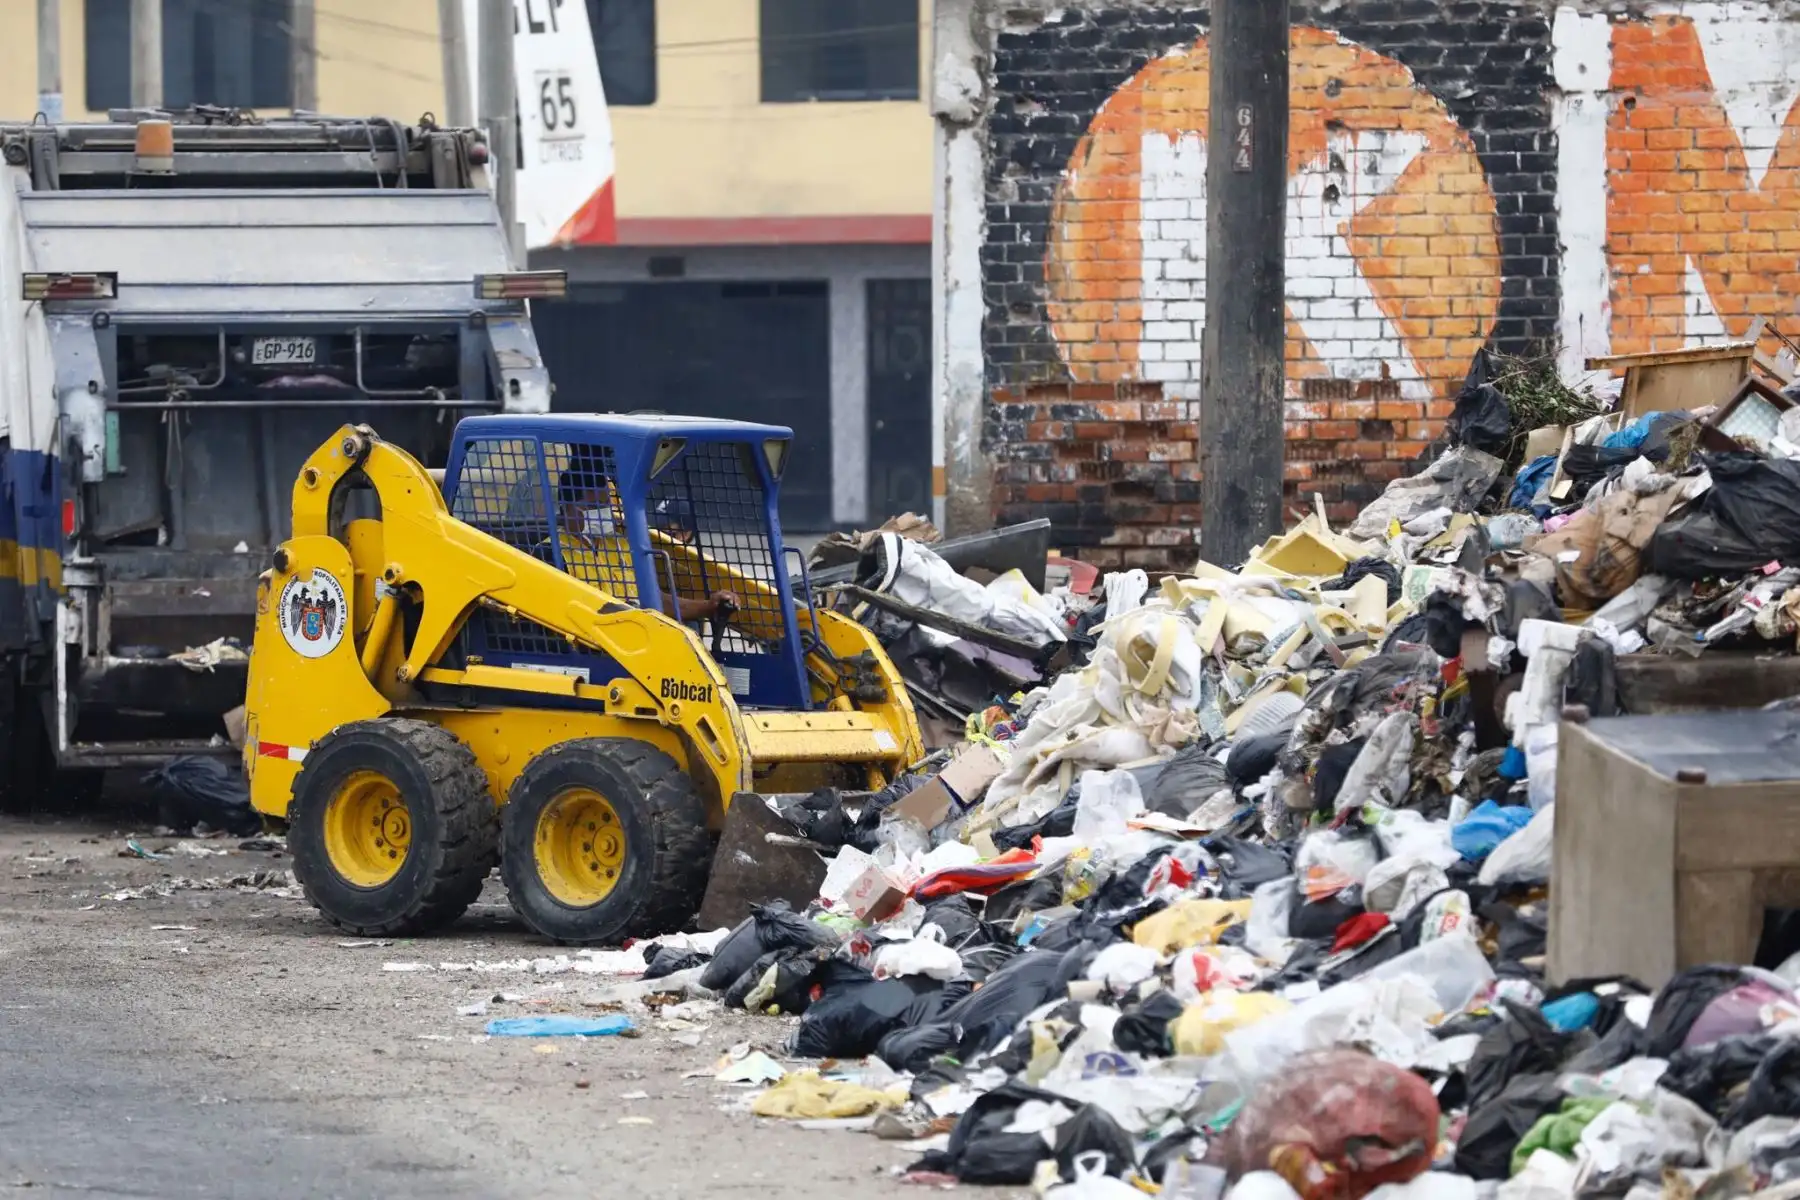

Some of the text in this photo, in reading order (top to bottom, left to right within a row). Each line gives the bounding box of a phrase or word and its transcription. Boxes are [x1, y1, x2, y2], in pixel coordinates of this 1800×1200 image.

[540, 77, 576, 131] 65
[1235, 108, 1252, 168] 644
[661, 677, 713, 704] Bobcat
